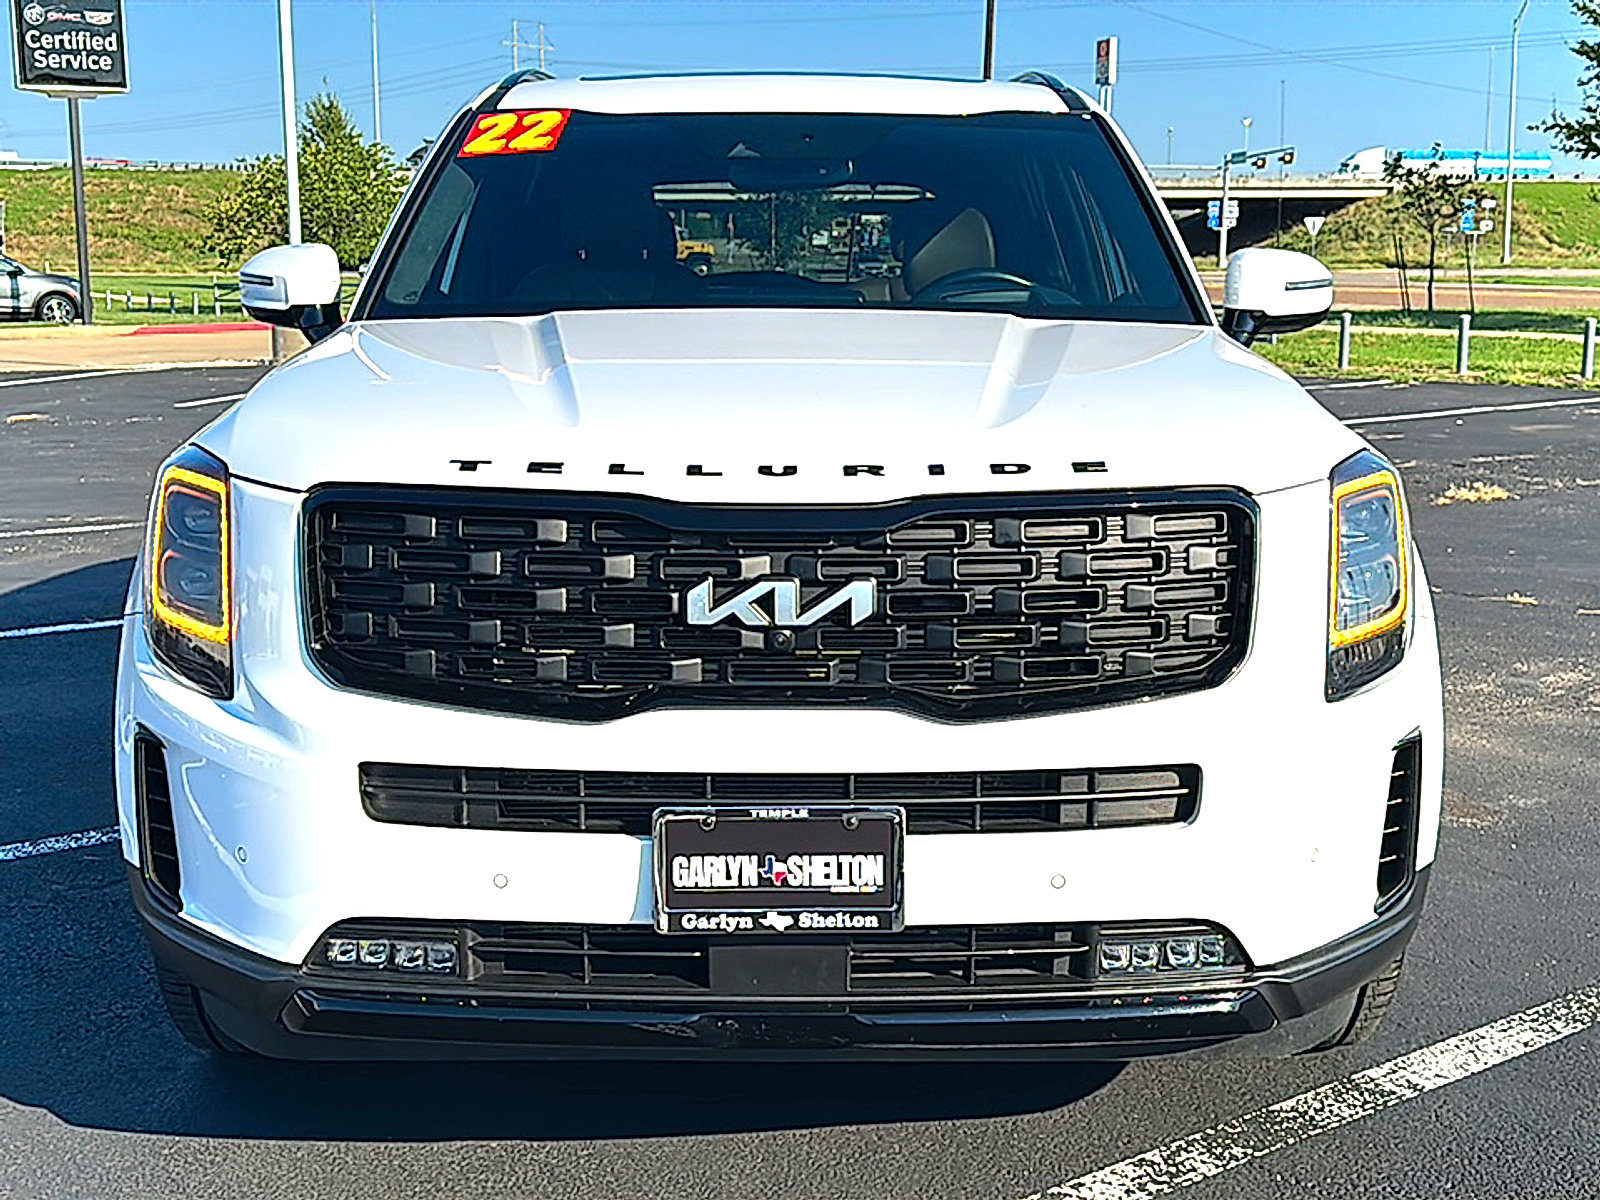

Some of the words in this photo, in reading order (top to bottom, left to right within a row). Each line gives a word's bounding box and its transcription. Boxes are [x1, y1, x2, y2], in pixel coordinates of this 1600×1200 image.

[25, 30, 118, 51] Certified
[33, 50, 112, 70] Service
[463, 111, 563, 154] 22
[449, 459, 1109, 477] TELLURIDE
[749, 809, 809, 818] TEMPLE
[672, 855, 758, 887] GARLYN
[787, 855, 884, 887] SHELTON
[681, 913, 754, 932] Garlyn
[798, 912, 879, 928] Shelton
